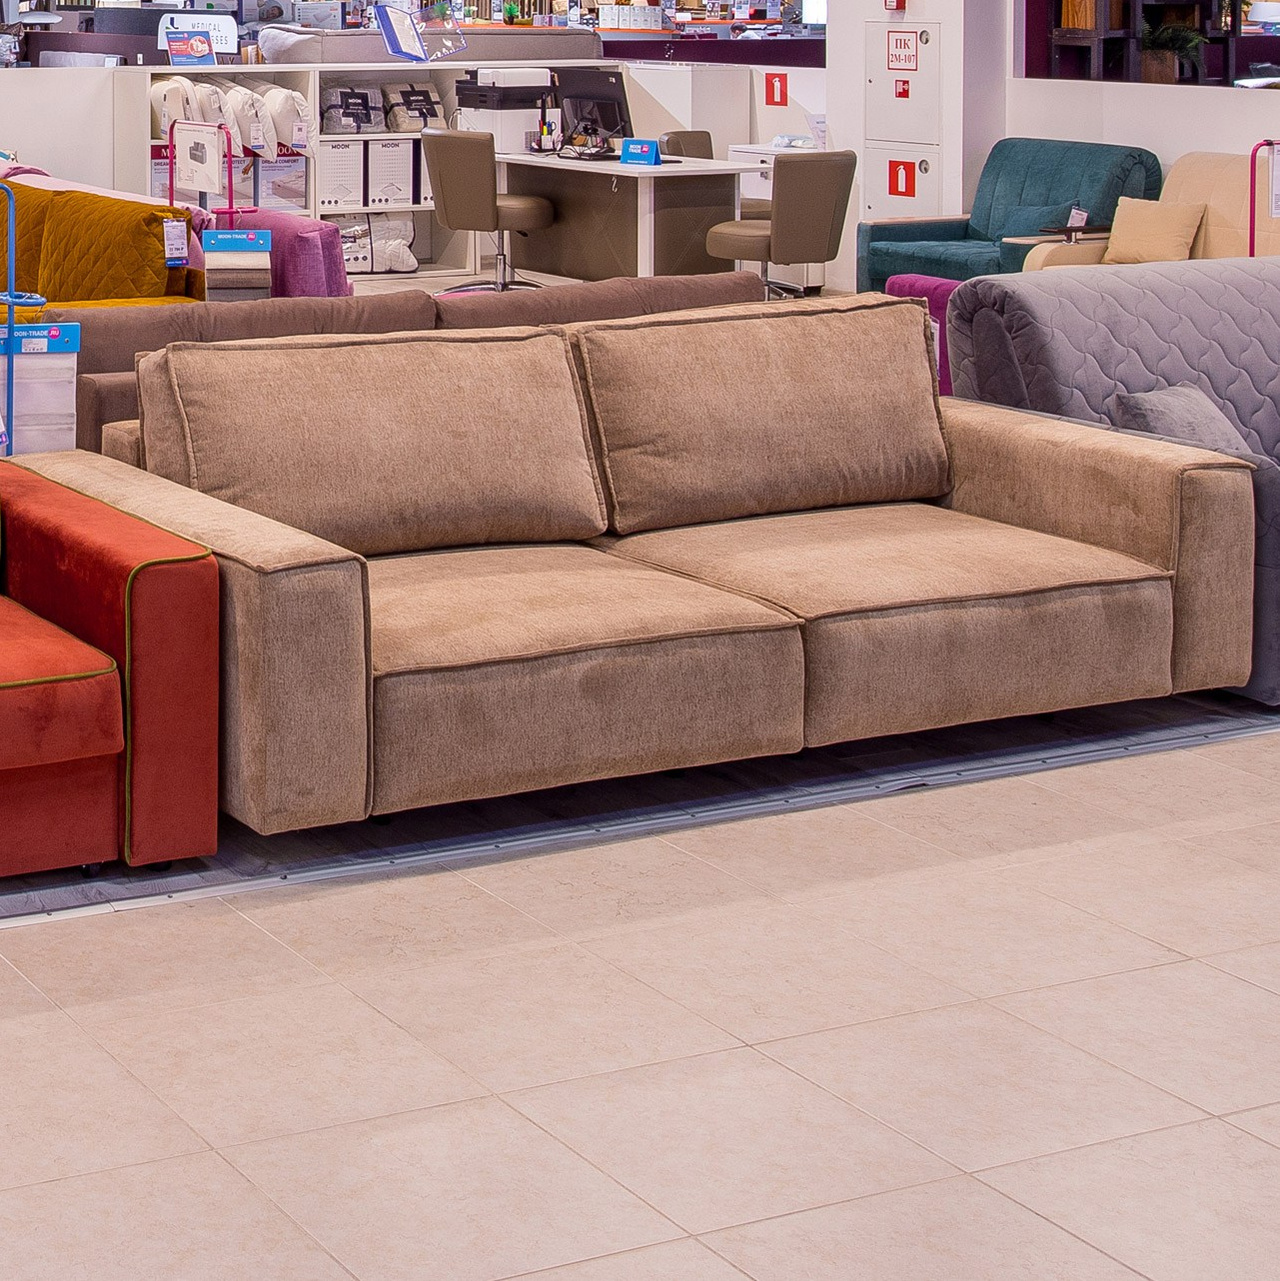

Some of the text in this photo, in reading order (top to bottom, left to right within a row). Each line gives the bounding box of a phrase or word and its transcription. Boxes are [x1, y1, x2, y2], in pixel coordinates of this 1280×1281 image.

[191, 22, 221, 32] MEDICAL
[894, 38, 911, 50] ПК
[14, 330, 48, 338] OON-TRADE
